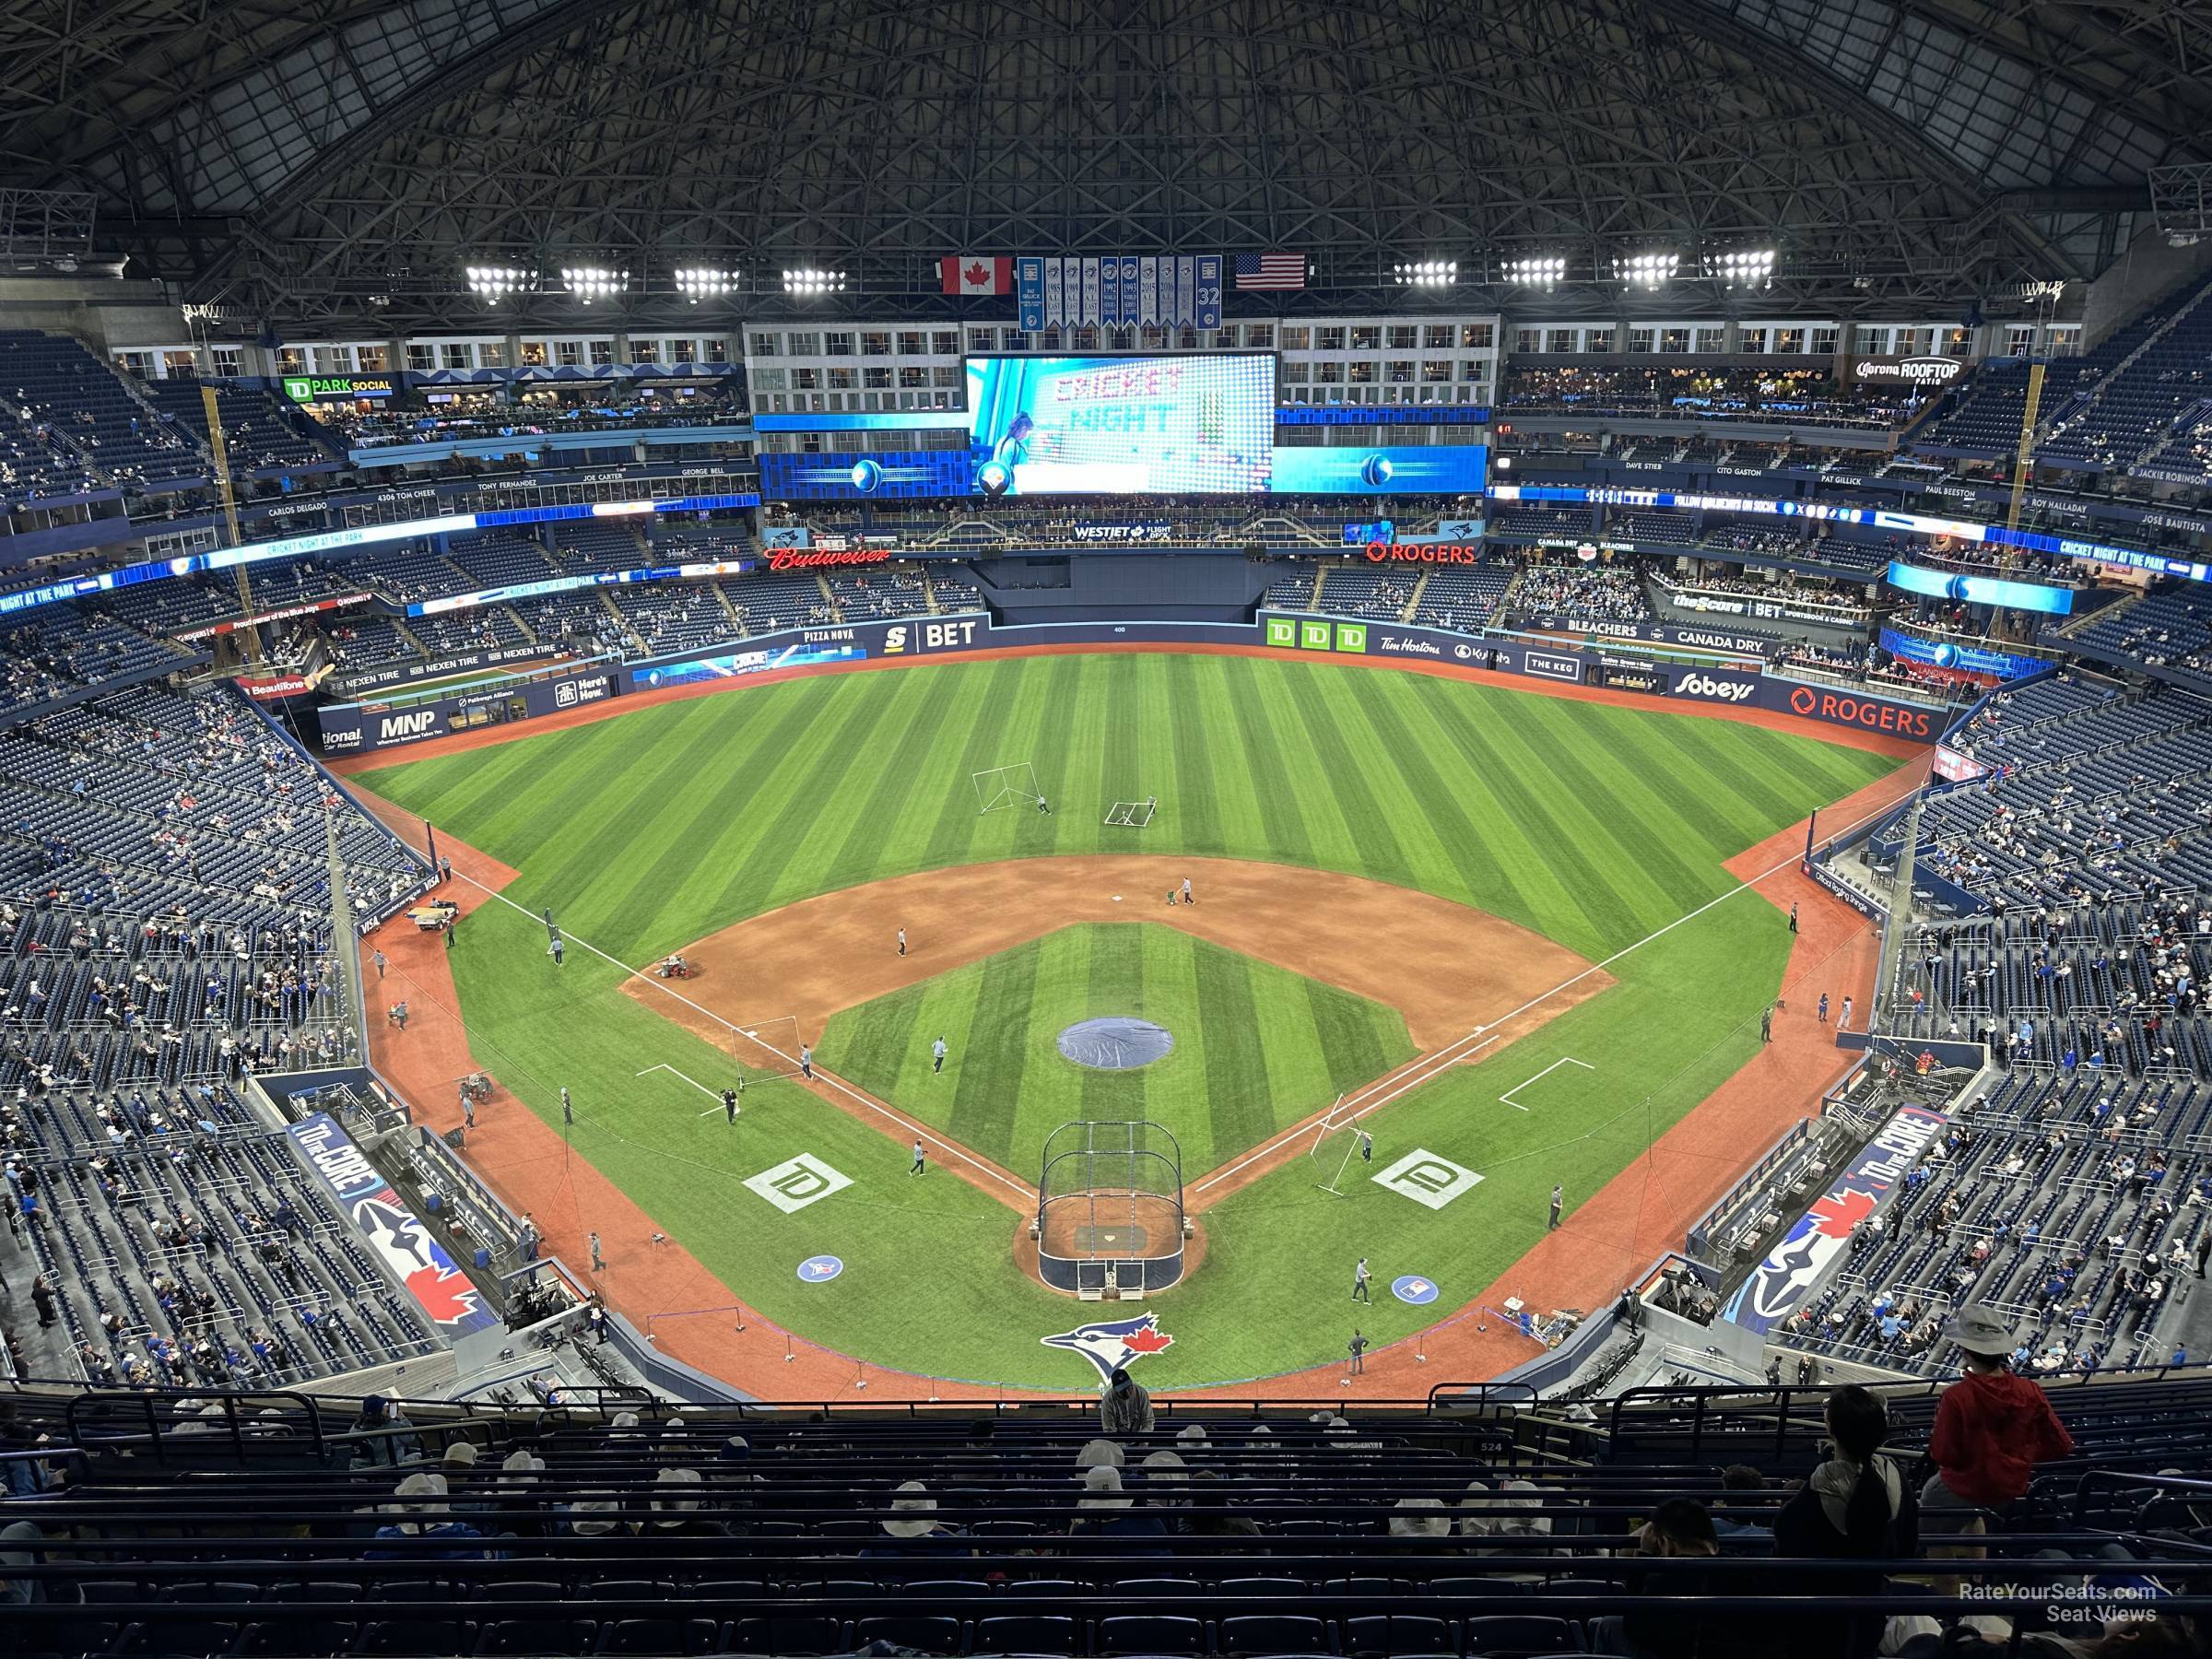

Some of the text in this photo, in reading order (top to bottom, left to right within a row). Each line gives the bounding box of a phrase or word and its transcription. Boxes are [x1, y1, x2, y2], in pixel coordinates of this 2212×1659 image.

[1047, 283, 1061, 293] 1985
[1085, 283, 1097, 293] 1991
[1103, 283, 1116, 293] 1992
[1124, 283, 1136, 293] 1993
[1142, 282, 1156, 292] 2015
[1197, 287, 1220, 305] 32
[1856, 361, 1959, 378] Corona ROOFTOP
[287, 379, 392, 398] TD PARK SOCIAL
[1735, 468, 1761, 477] GASTON
[2138, 469, 2207, 485] JACKIE ROBINSON
[477, 479, 537, 491] TONY FERNANDEZ
[1835, 477, 1862, 485] GILLICK
[378, 489, 436, 502] 4306 TOM CHEEK
[1926, 486, 1976, 498] PAUL BEESTON
[268, 502, 327, 517] CARLOS DELGADO
[1674, 495, 1701, 508] FOLLOW
[2031, 499, 2087, 513] ROY HALLADAY
[2142, 515, 2205, 533] JOSÉ BAUTISTA
[1075, 527, 1130, 538] WESTJET
[299, 538, 319, 550] NIGHT
[1538, 538, 1565, 547] CANADA
[1600, 542, 1634, 550] BLEACHERS
[764, 547, 891, 570] Budweiser
[1391, 543, 1476, 564] ROGERS
[2060, 541, 2093, 557] CRICKET
[2093, 545, 2118, 562] NIGHT
[2118, 551, 2129, 564] AT
[2129, 553, 2144, 567] THE
[2145, 557, 2165, 571] PARK
[25, 592, 36, 606] AT
[37, 588, 53, 603] THE
[53, 582, 76, 599] PARK
[343, 594, 364, 606] ROGERS
[233, 604, 320, 630] Proud owner of the Blue Jays
[1673, 594, 1744, 613] theScore
[1755, 602, 1783, 619] BET
[1785, 610, 1824, 622] SPORTSBOOK
[1830, 616, 1854, 626] CASINO
[183, 630, 208, 641] ROGERS
[804, 628, 854, 642] PIZZA NOVA
[926, 622, 976, 647] BET
[1271, 624, 1293, 641] TD
[1305, 627, 1327, 643] TD
[1568, 619, 1638, 637] BLEACHERS
[1340, 629, 1363, 646] TD
[1677, 631, 1733, 649] CANADA
[1736, 639, 1764, 653] DRY.
[503, 647, 534, 659] NEXEN
[535, 643, 556, 655] TIRE
[1381, 637, 1440, 655] Tim Hortons
[426, 660, 456, 673] NEXEN
[458, 656, 479, 667] TIRE
[1531, 659, 1573, 673] THE KEG
[346, 675, 377, 688] NEXEN
[379, 670, 400, 682] TIRE
[1919, 667, 1953, 679] LANDING
[252, 680, 305, 696] BeautiTone
[578, 676, 607, 690] Here's
[1675, 673, 1754, 701] Sobeys
[580, 689, 604, 701] How.
[1822, 694, 1930, 736] ROGERS
[381, 711, 435, 738] MNP
[337, 741, 360, 749] Rental
[424, 874, 440, 891] VISA
[1816, 872, 1868, 912] Official Roofing Shingle
[360, 915, 380, 934] VISA
[1858, 1112, 1940, 1184] TO THE CORE
[293, 1123, 373, 1190] TO THE CORE
[771, 1161, 830, 1200] TD
[1481, 1442, 1501, 1452] 524
